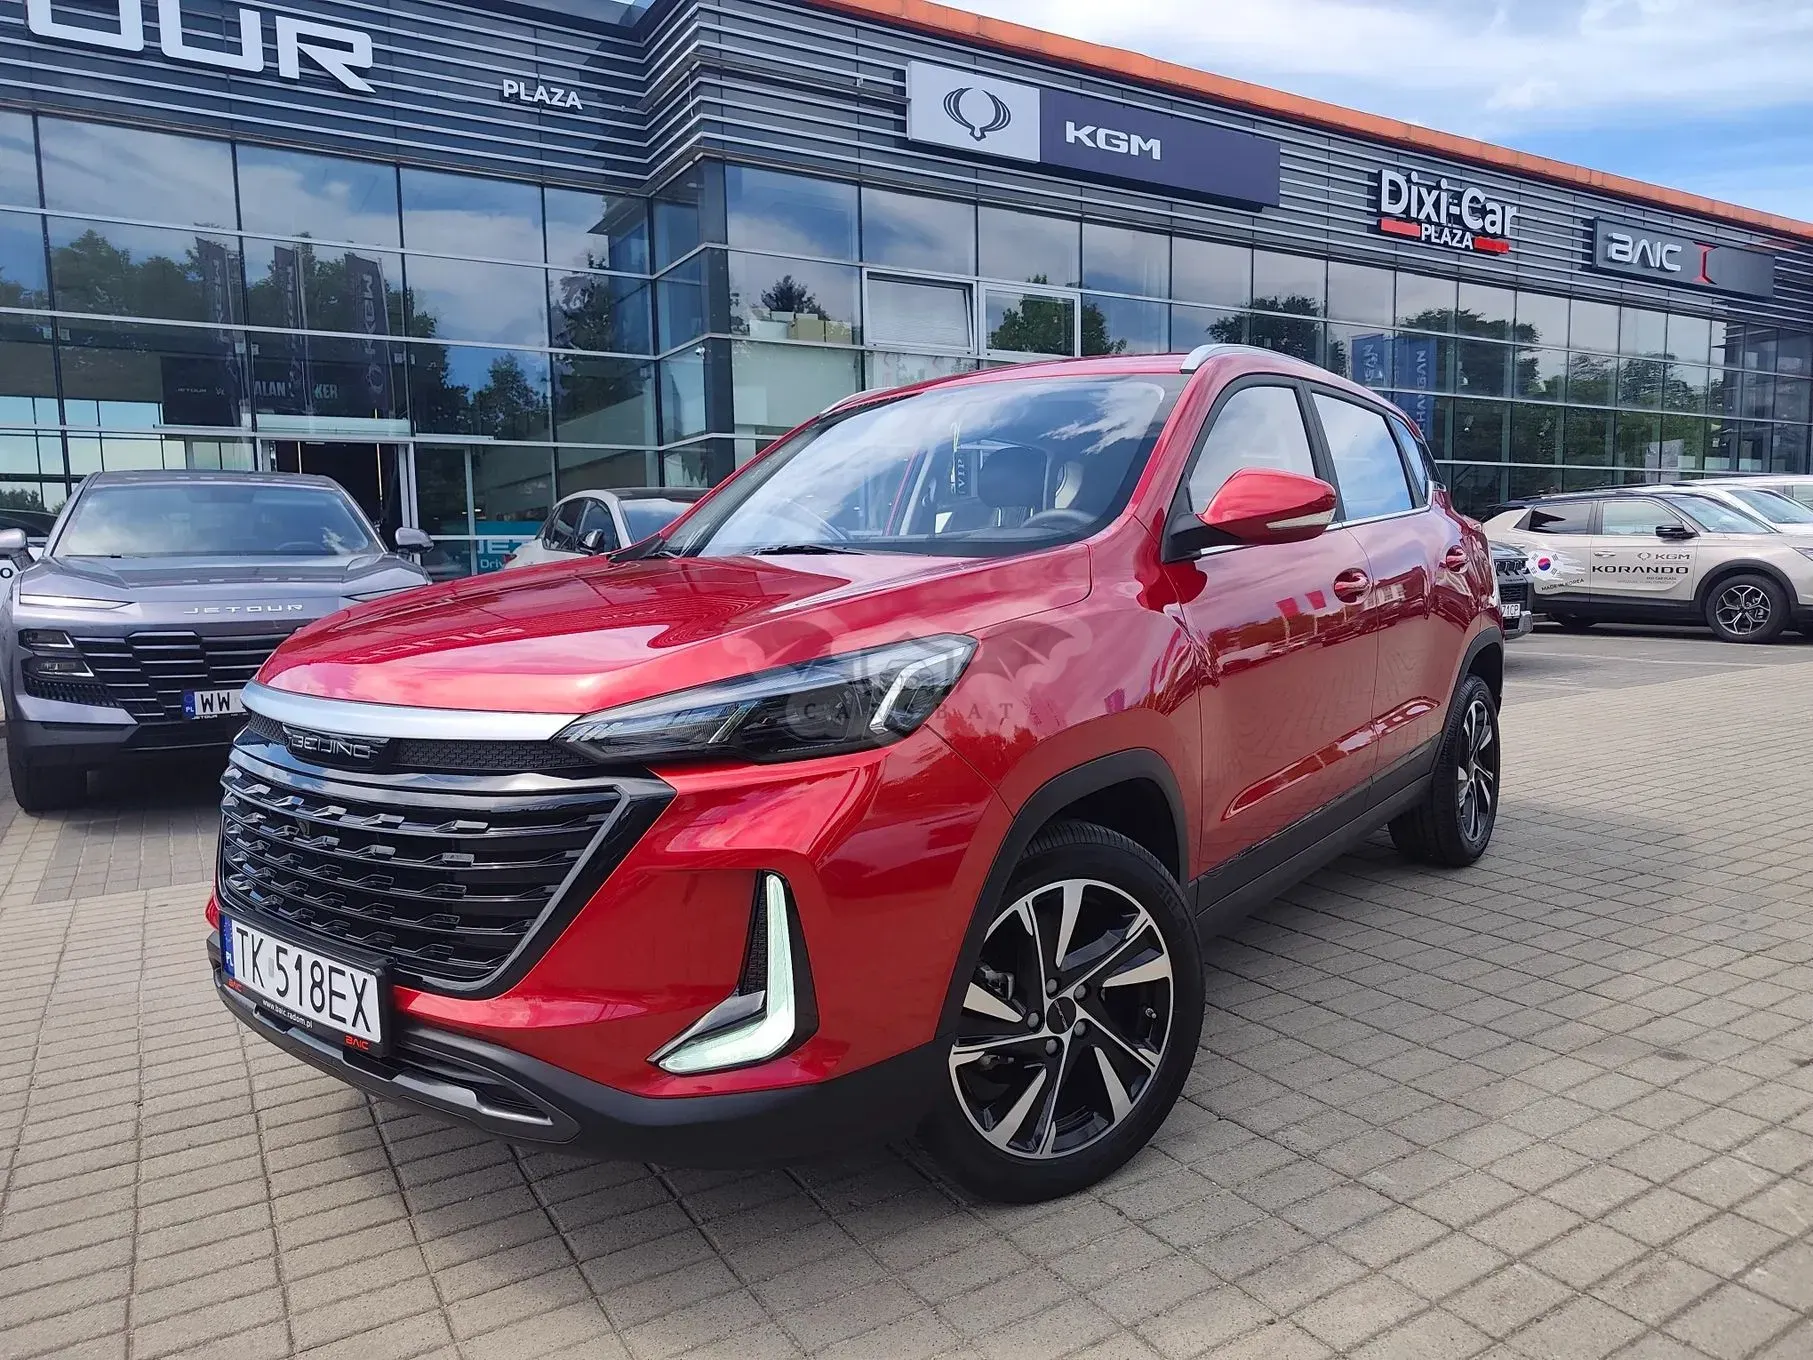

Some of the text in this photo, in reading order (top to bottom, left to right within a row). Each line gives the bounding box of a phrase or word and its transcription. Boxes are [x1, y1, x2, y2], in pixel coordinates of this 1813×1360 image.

[503, 79, 582, 110] PLAZA
[1065, 120, 1161, 160] KGM
[1380, 168, 1517, 236] Dixi-Car
[1421, 223, 1474, 250] PLAZA
[1607, 232, 1682, 272] BAIC
[1592, 565, 1689, 574] KORANDO
[183, 604, 303, 615] JETOUR
[200, 691, 230, 713] WW
[289, 734, 371, 759] BEIJING
[236, 927, 371, 1032] TK 518EX
[262, 1000, 313, 1029] www.baic.radom.pl
[345, 1035, 369, 1050] BAIC
